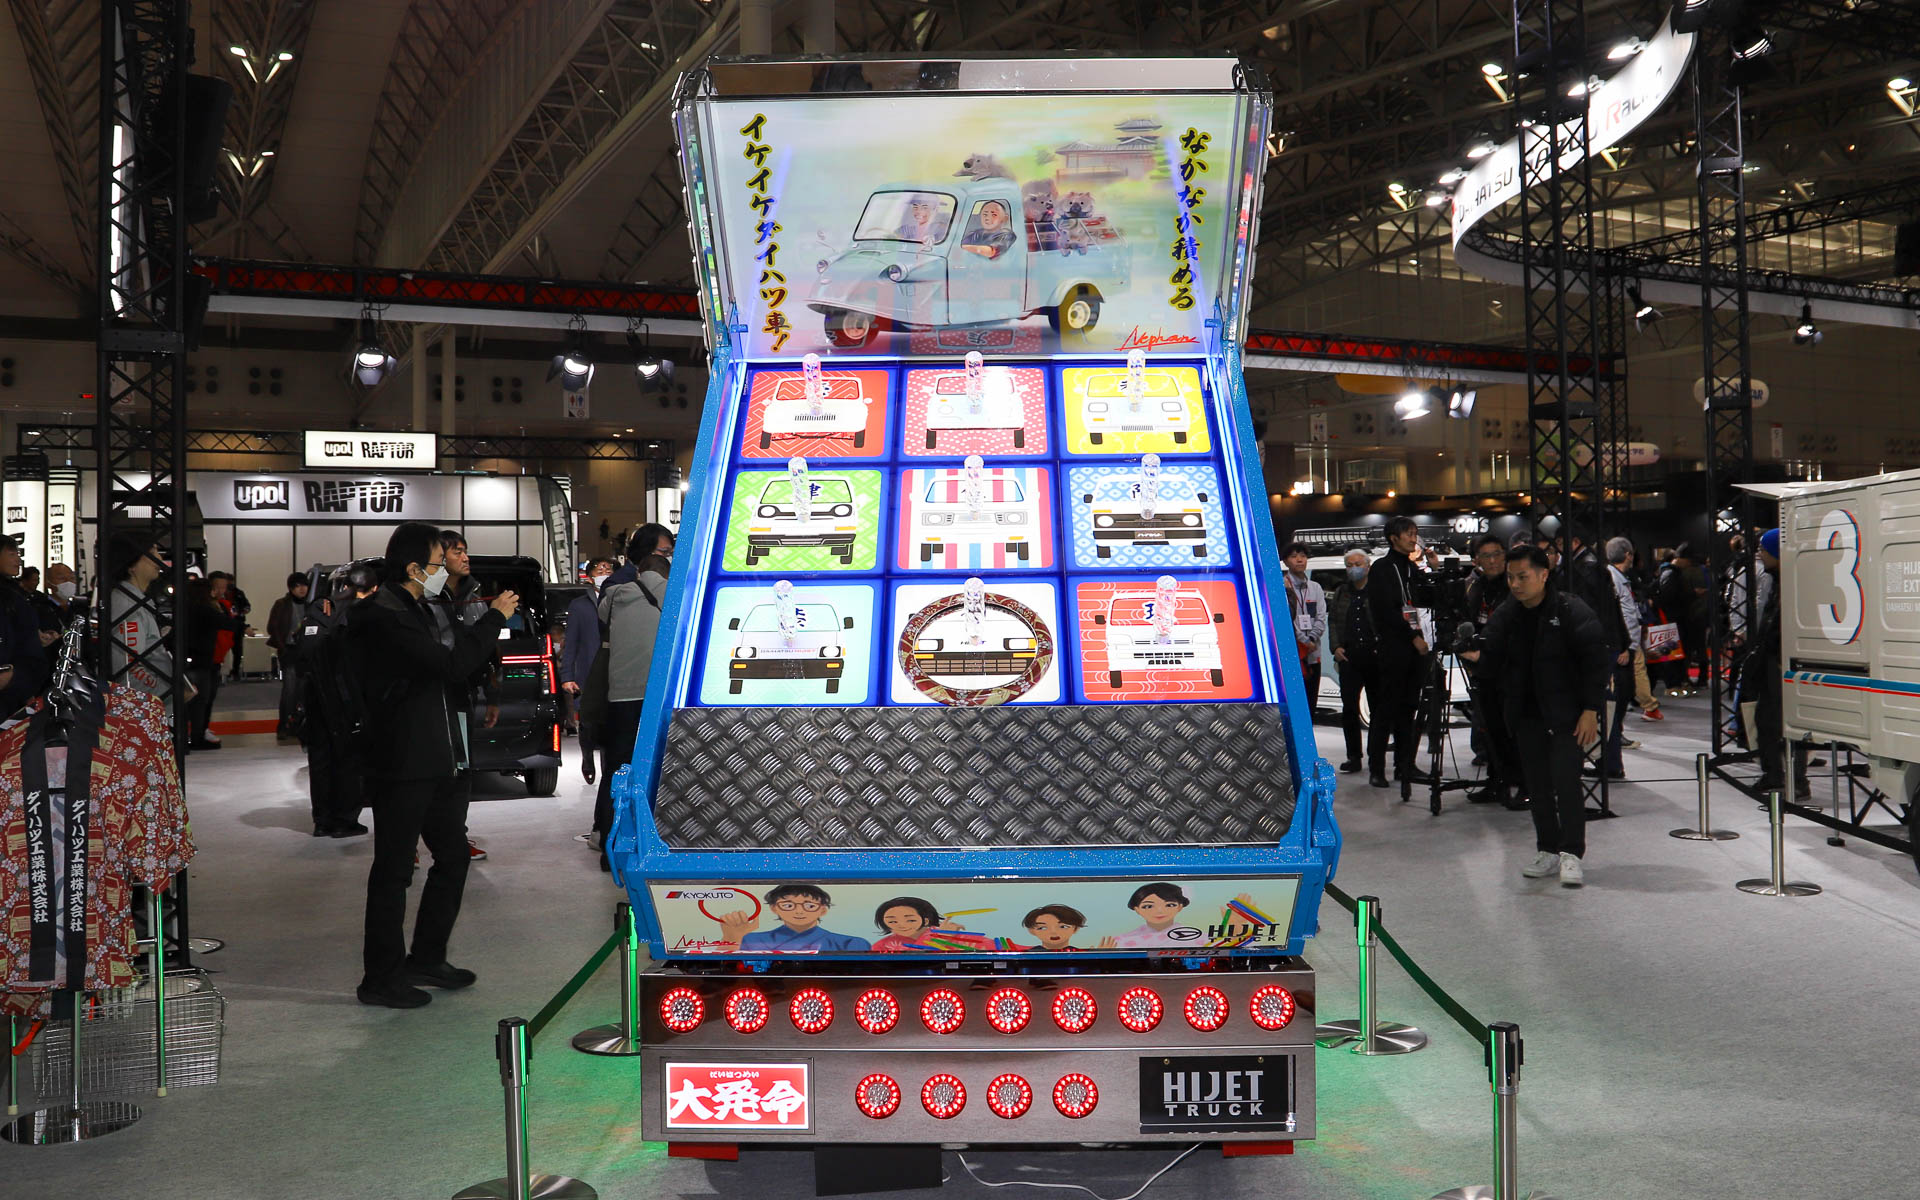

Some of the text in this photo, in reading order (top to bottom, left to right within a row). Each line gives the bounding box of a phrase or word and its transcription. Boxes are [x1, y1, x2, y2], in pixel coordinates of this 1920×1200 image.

[1169, 128, 1210, 310] なかなか積める
[325, 441, 414, 458] upol RAPTOR
[236, 480, 405, 513] upol RAPTOR
[1448, 517, 1489, 533] TOM'S
[51, 524, 63, 563] RAPT
[1816, 509, 1864, 645] 3
[27, 790, 48, 923] ダイハツ工業株式会社
[70, 799, 86, 932] ダイハツ工業株式会社
[1208, 923, 1280, 937] HIJET
[669, 1078, 805, 1124] 大発命
[1163, 1071, 1264, 1102] HIJET
[1165, 1103, 1263, 1117] TRUCK
